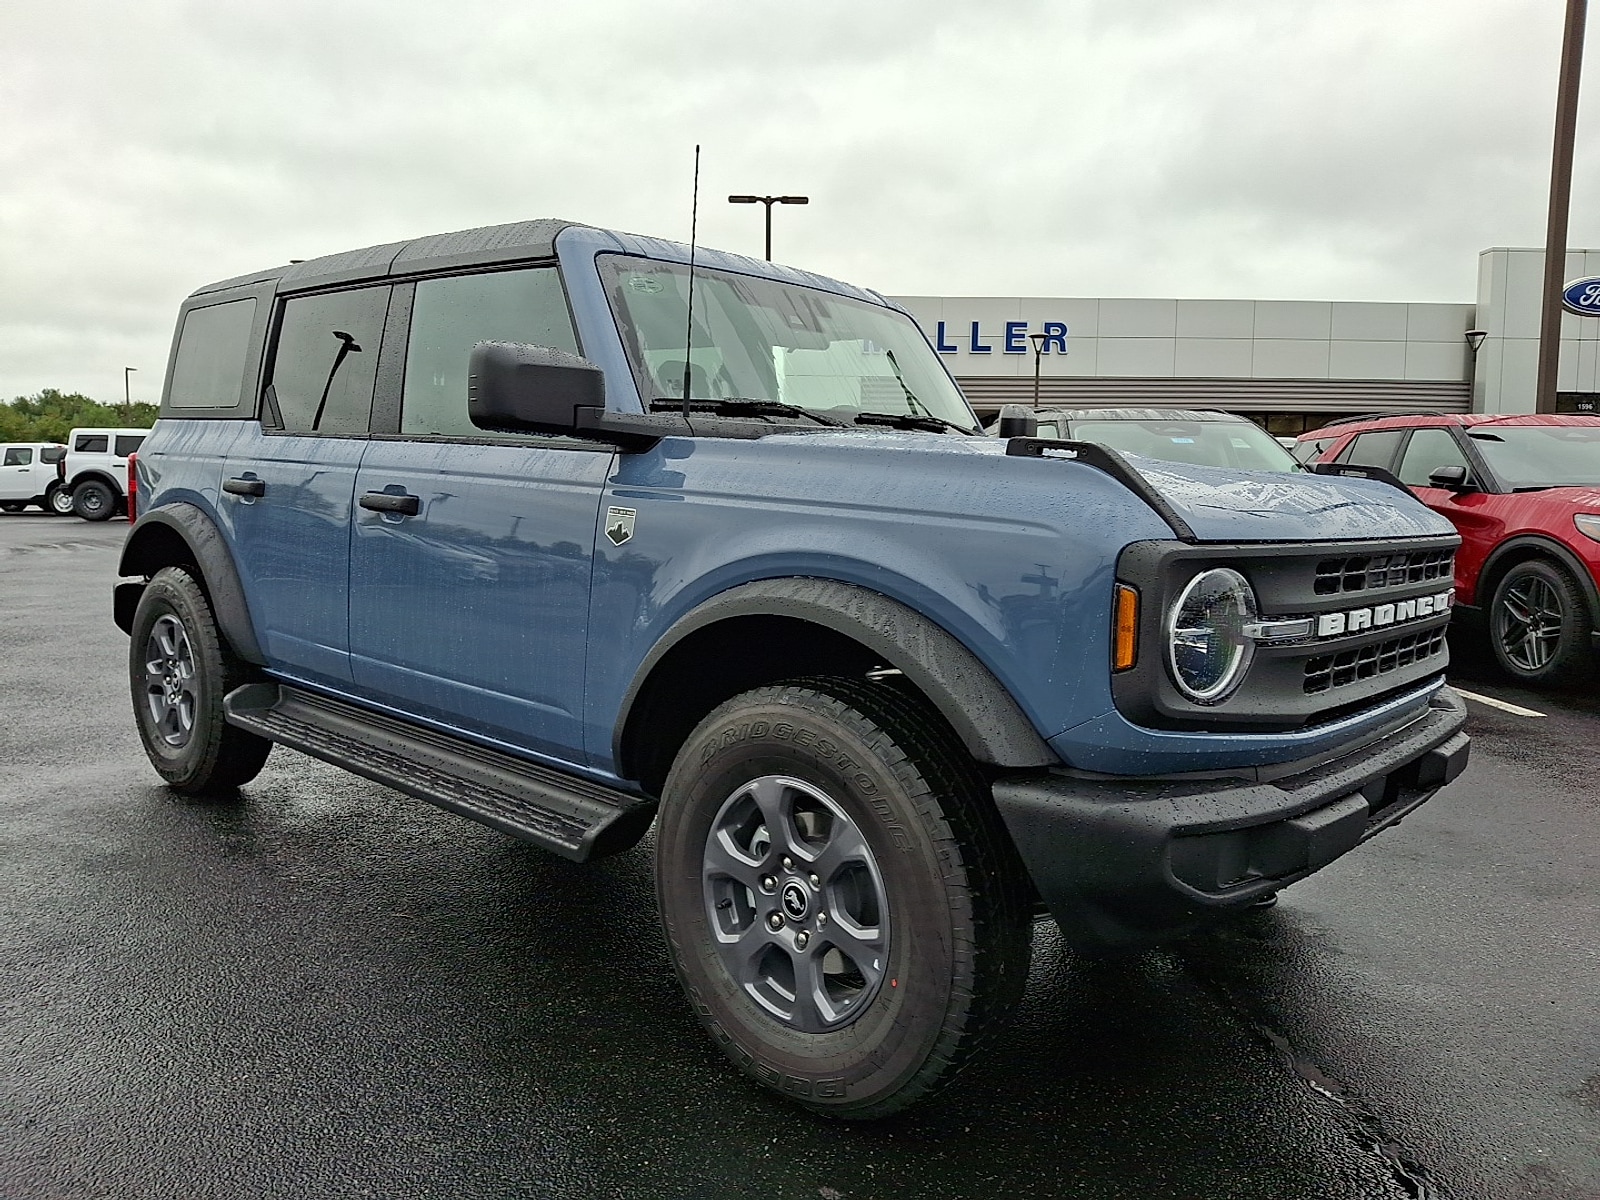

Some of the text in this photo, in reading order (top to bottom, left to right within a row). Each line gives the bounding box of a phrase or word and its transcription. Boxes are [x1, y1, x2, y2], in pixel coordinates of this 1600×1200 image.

[864, 320, 1068, 354] LLER
[1318, 591, 1451, 637] BRONCO
[701, 720, 917, 854] BRIDGESTONE
